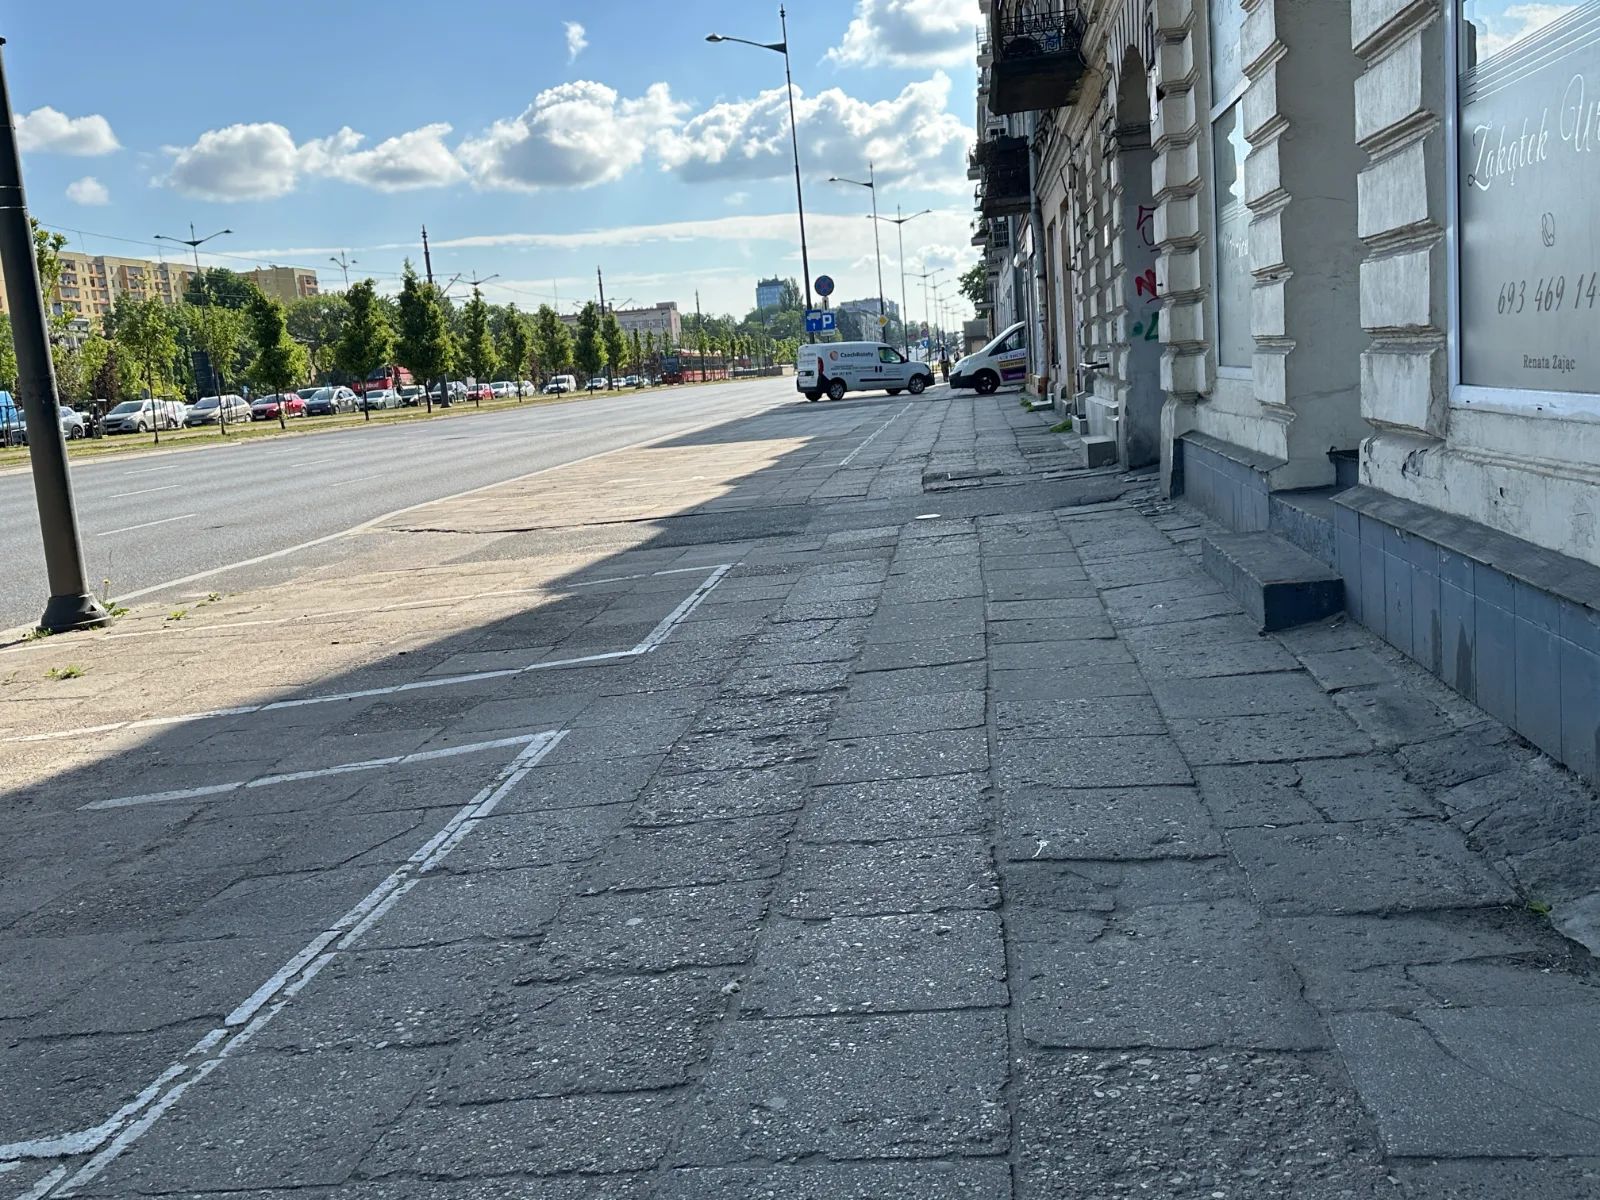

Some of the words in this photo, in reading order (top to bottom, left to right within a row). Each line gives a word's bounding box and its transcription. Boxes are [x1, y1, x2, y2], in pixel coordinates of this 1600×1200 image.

[1467, 108, 1549, 191] Zakątek
[1560, 74, 1600, 152] U
[1498, 279, 1526, 315] 693
[1534, 275, 1565, 313] 469
[1574, 272, 1600, 310] 14
[822, 314, 832, 328] P
[1523, 354, 1550, 369] Renata
[1552, 354, 1576, 374] Zając
